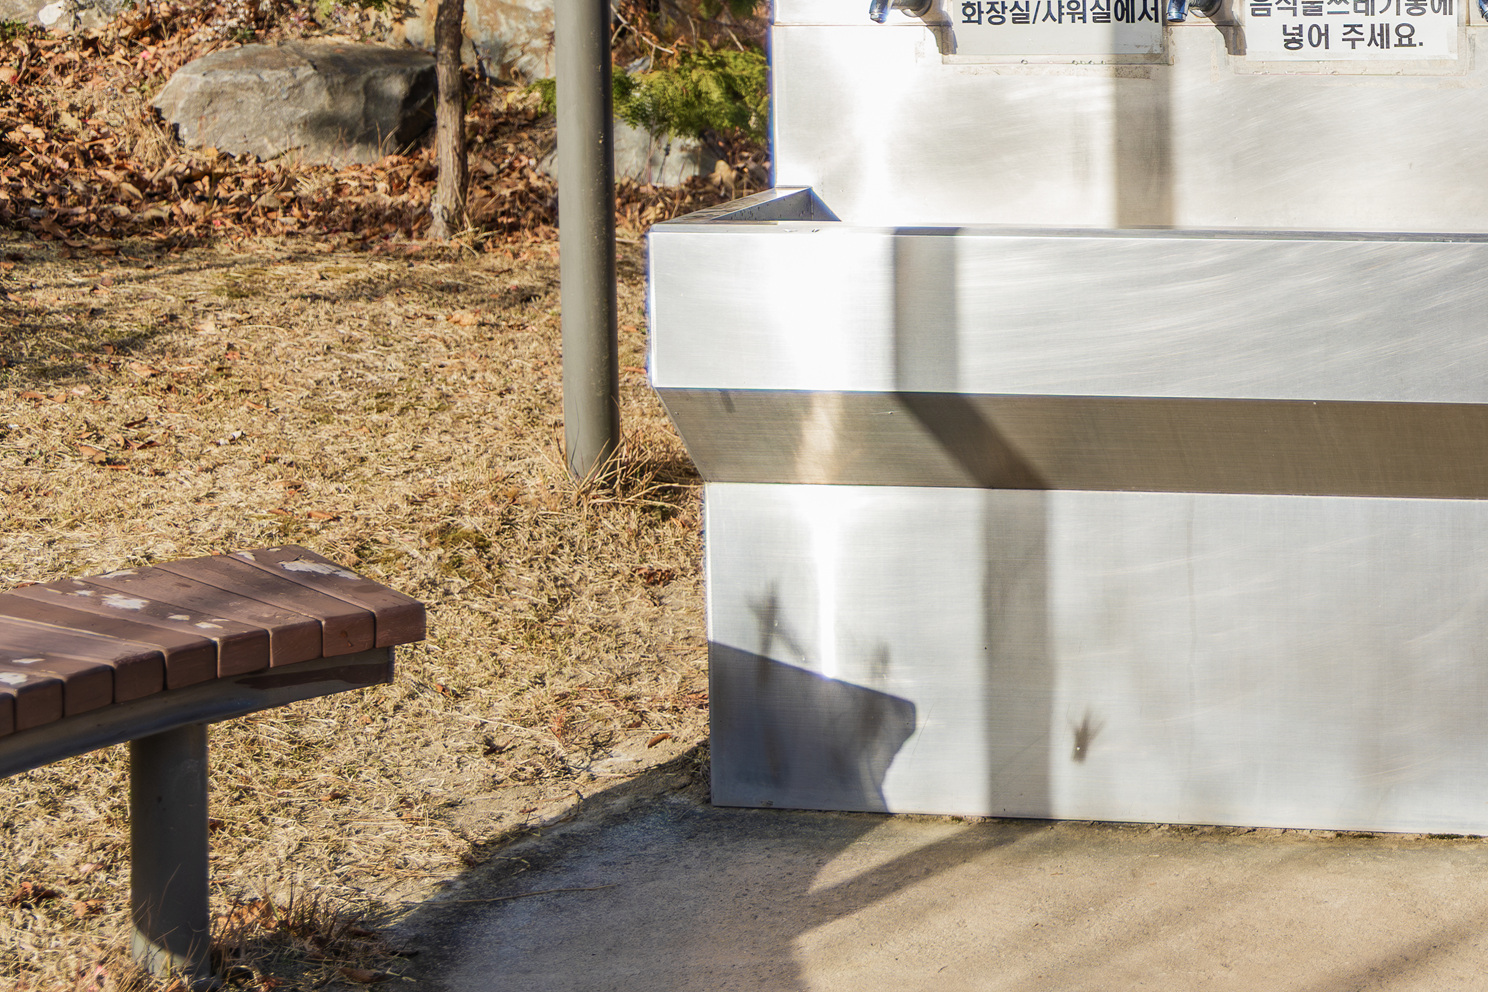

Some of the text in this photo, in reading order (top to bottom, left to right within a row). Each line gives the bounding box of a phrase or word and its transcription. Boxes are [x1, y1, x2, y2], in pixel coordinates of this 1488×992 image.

[961, 0, 1159, 25] 화장실/샤워실에서
[1283, 23, 1423, 50] 넣어 주세요.
